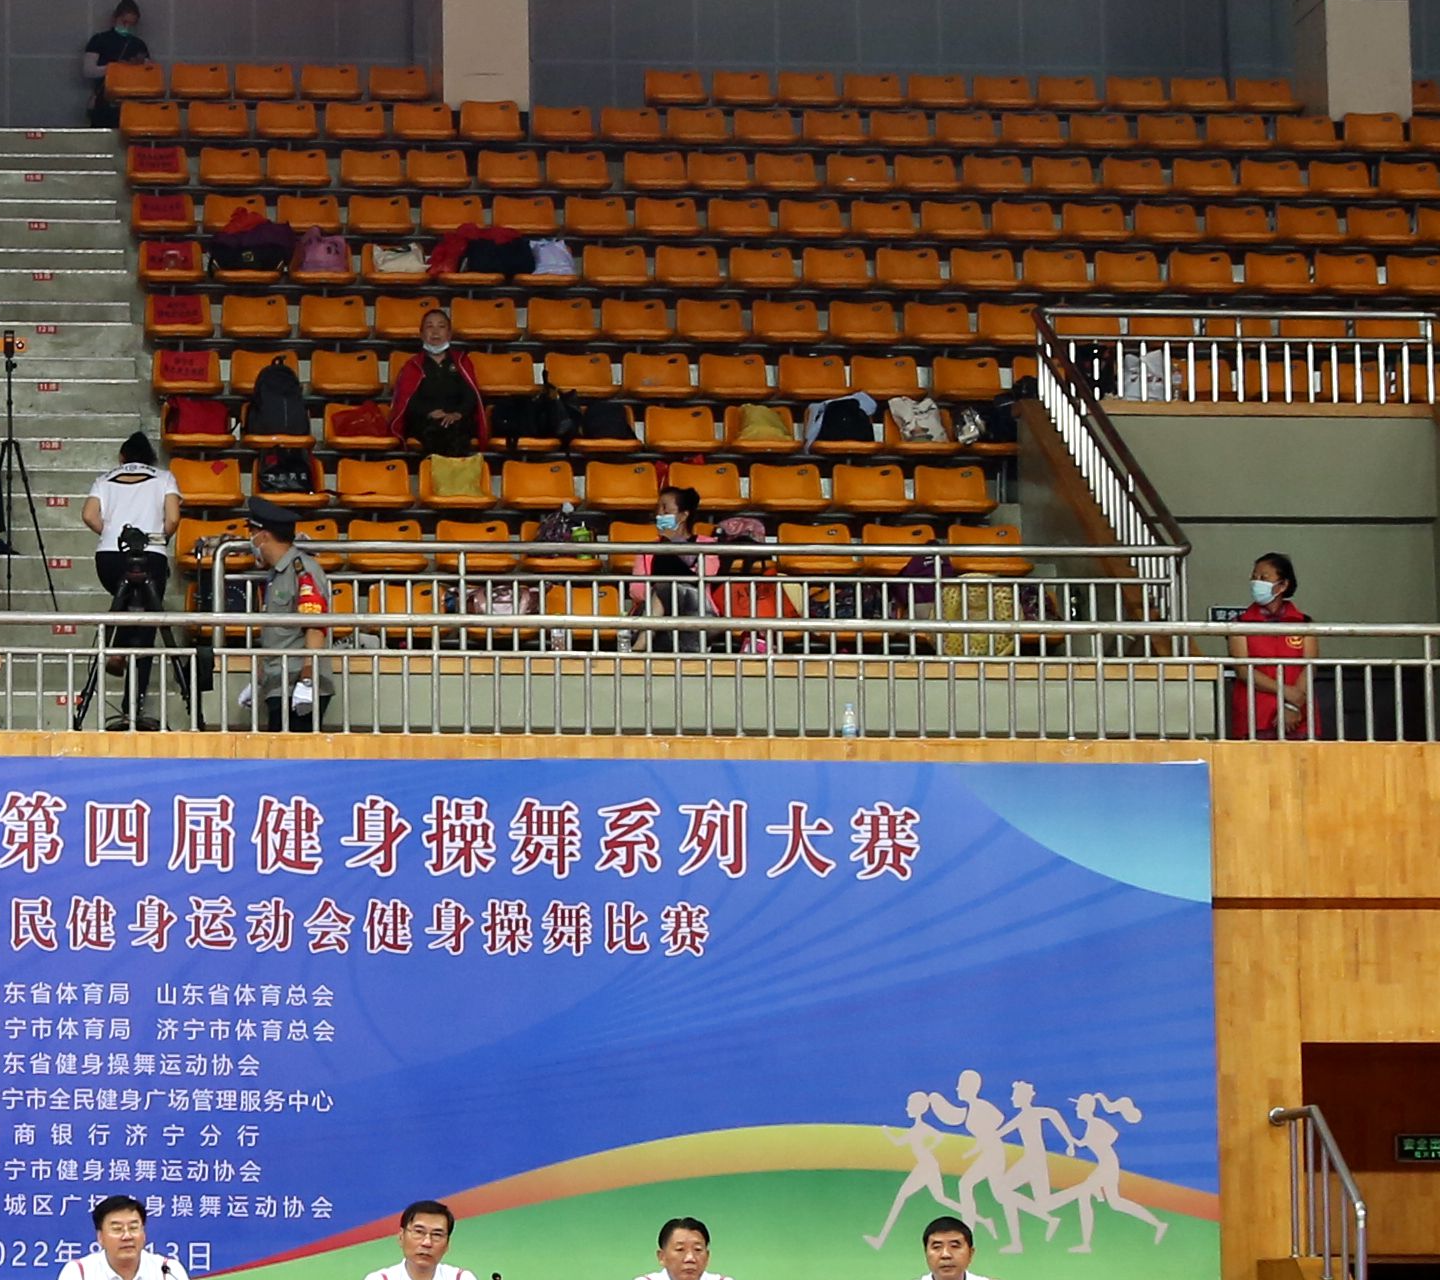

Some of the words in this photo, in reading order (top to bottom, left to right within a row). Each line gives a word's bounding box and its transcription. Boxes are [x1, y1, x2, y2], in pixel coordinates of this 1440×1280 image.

[156, 984, 335, 1008] 山东省体育总会
[156, 1018, 336, 1043] 济宁市体育总会
